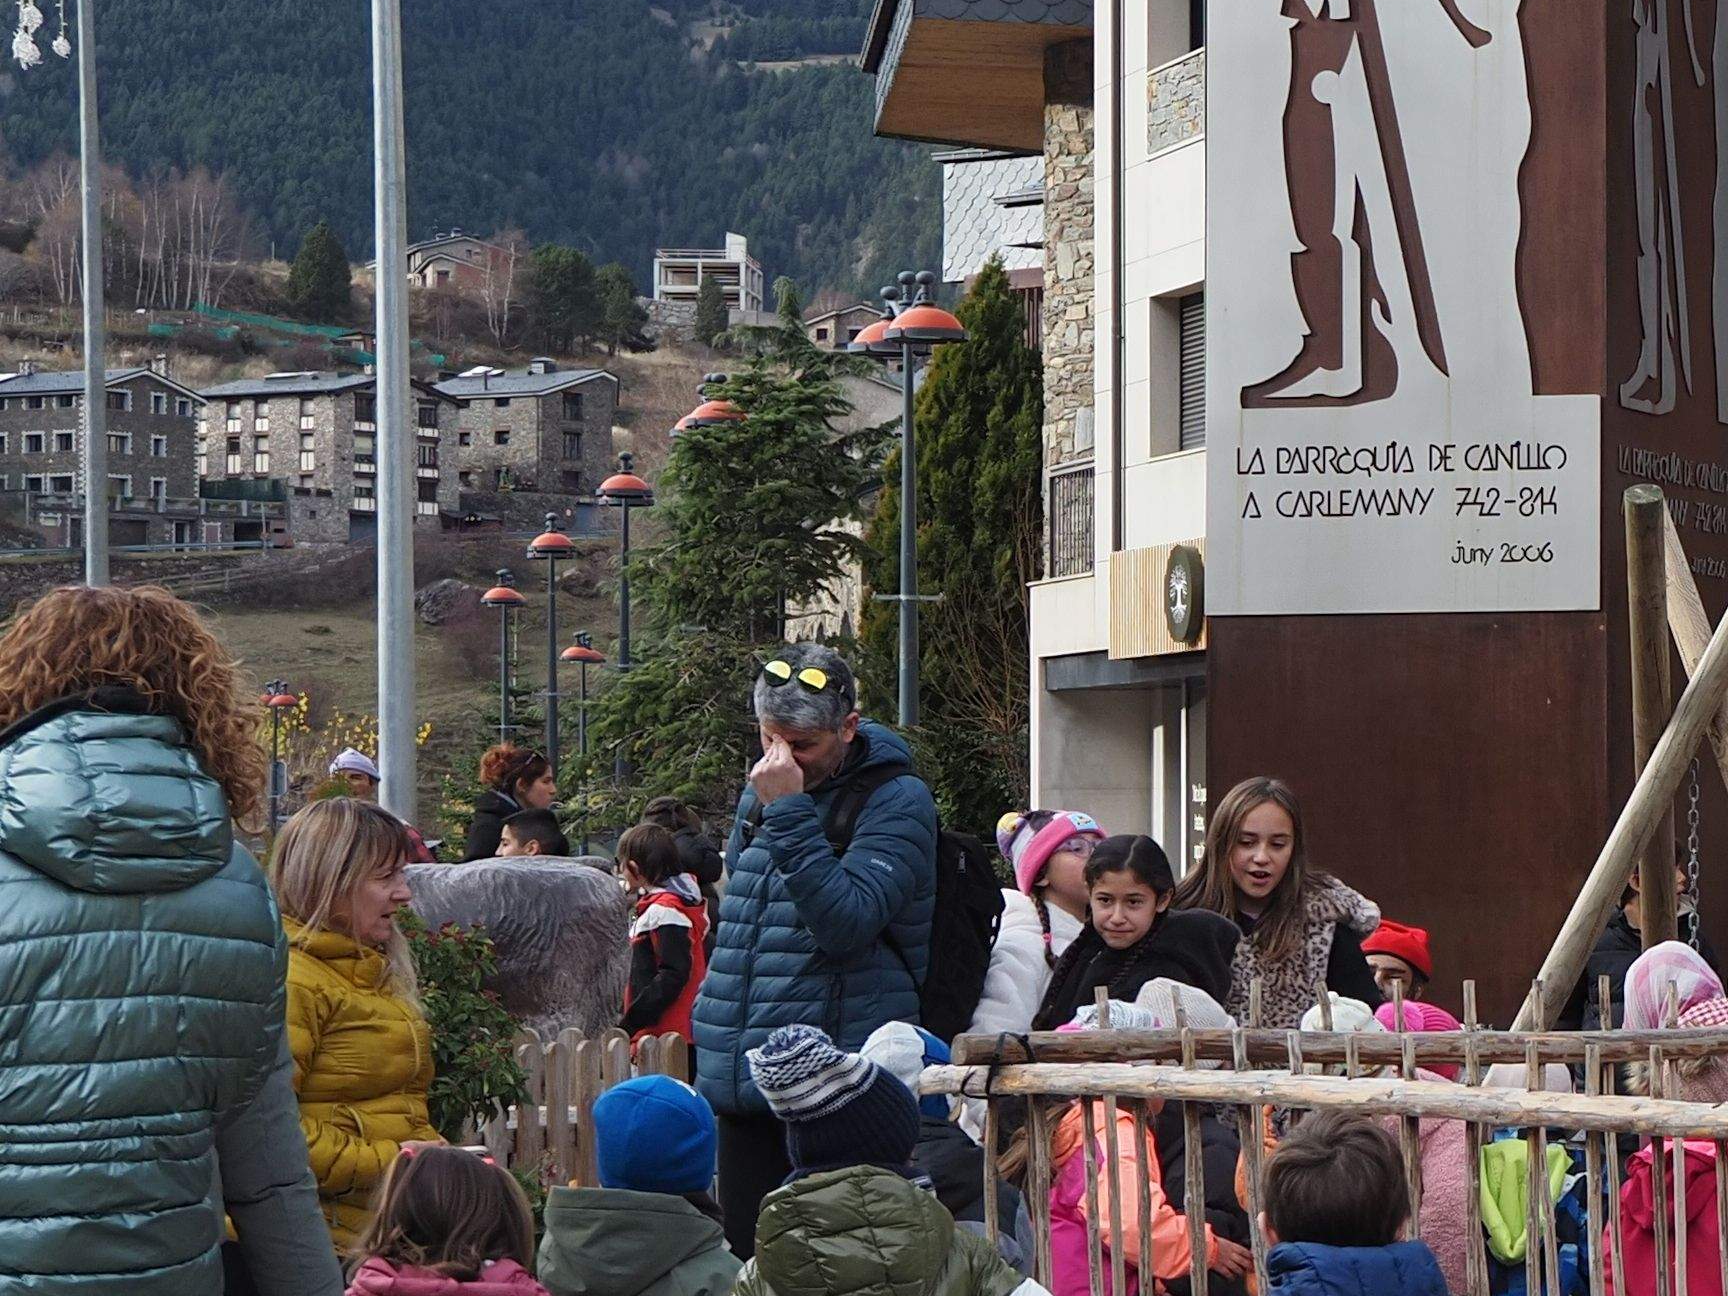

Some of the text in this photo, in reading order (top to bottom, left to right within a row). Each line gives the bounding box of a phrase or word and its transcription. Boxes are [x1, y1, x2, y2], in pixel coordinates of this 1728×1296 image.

[1237, 447, 1266, 475] LA
[1429, 444, 1456, 472] DE
[1464, 440, 1567, 472] CANILLO
[1242, 491, 1262, 518] A
[1275, 487, 1435, 517] CARLEMANY
[1452, 541, 1554, 566] juny 2006
